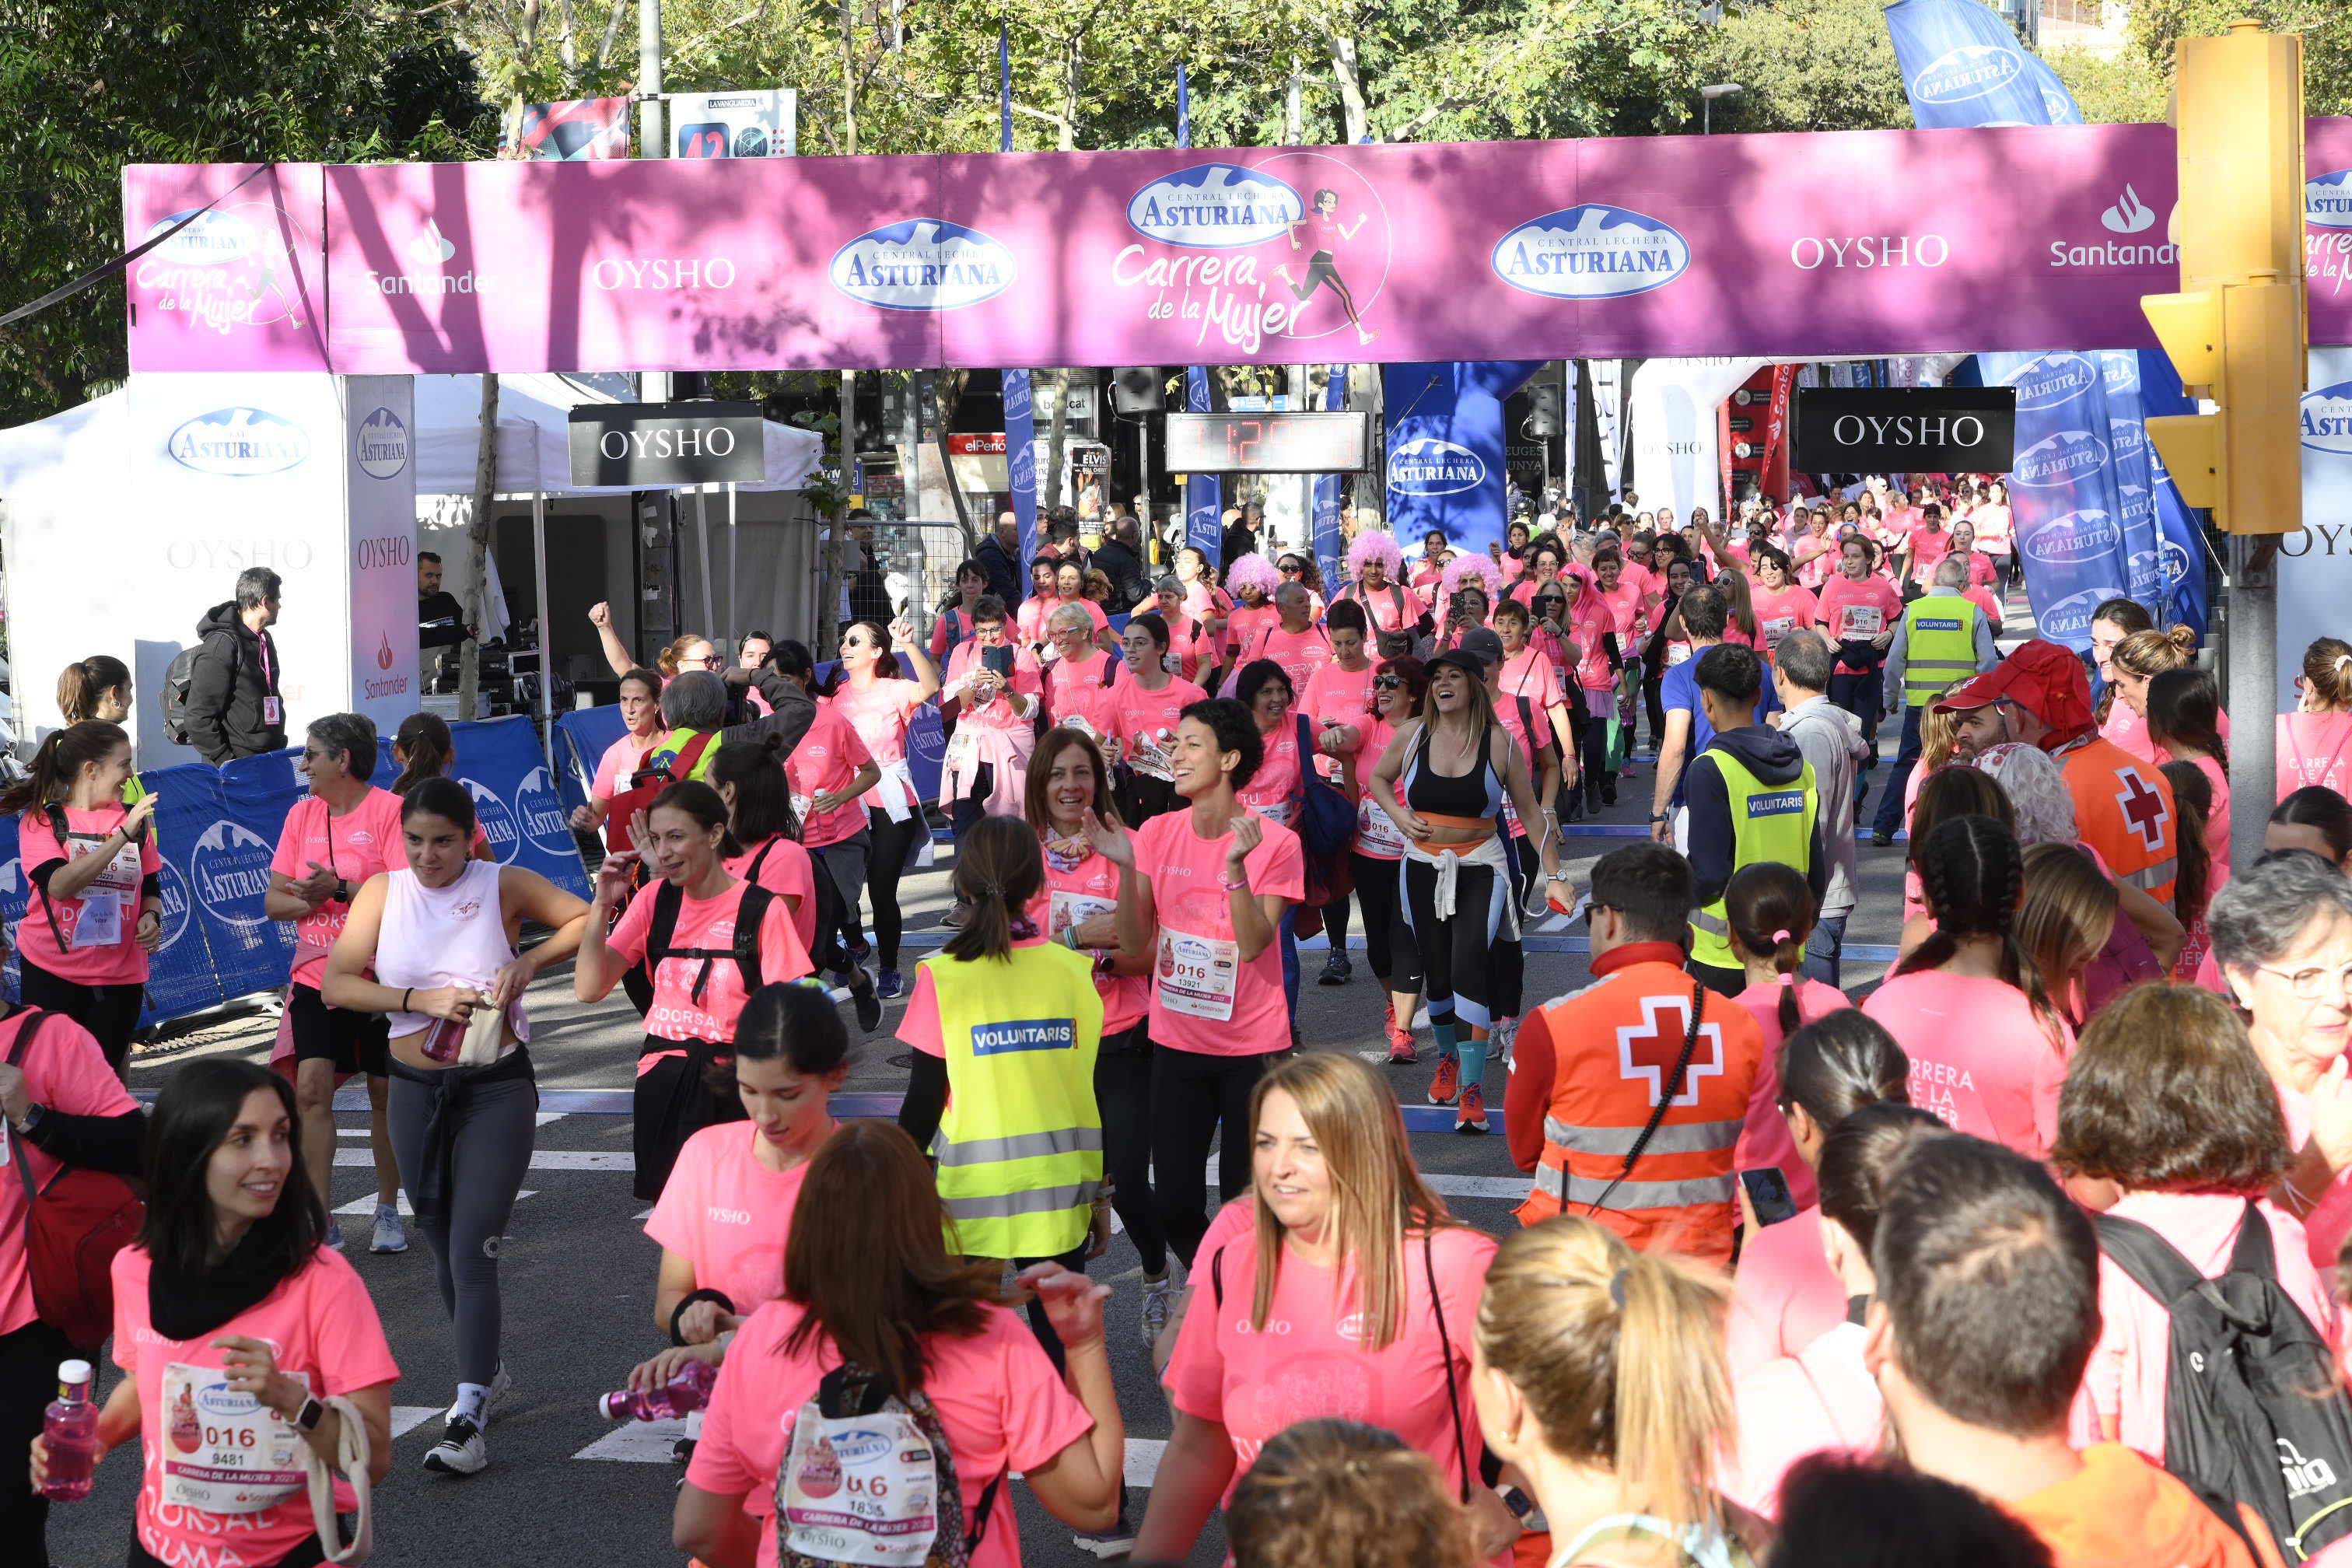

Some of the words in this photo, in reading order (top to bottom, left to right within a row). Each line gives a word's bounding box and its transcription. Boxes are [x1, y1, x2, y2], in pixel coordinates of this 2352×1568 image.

[1167, 192, 1224, 201] CENTRAL
[1229, 191, 1288, 201] LECHERA
[1141, 194, 1290, 228] ASTURIANA
[1537, 236, 1600, 247] CENTRAL
[1605, 236, 1668, 247] LECHERA
[1790, 234, 1949, 270] OYSHO
[873, 250, 933, 260] CENTRAL
[1112, 243, 1258, 287] Carrera
[1507, 240, 1675, 275] ASTURIANA
[2323, 254, 2337, 278] la
[137, 259, 227, 289] Carrera
[593, 258, 735, 290] OYSHO
[845, 253, 1002, 288] ASTURIANA
[364, 270, 500, 296] Santander
[159, 292, 176, 310] de
[190, 286, 261, 334] Mujer
[1148, 289, 1174, 320] de
[1181, 288, 1201, 320] la
[1195, 282, 1313, 355] Mujer
[1833, 415, 1984, 446] OYSHO
[360, 434, 405, 462] ASTURIANA
[600, 427, 737, 461] OYSHO
[1083, 454, 1107, 464] ELVIS
[1391, 460, 1479, 483] ASTURIANA
[358, 535, 411, 571] OYSHO
[365, 673, 409, 700] Santander
[530, 796, 556, 809] CENTRAL
[1748, 796, 1804, 813] VOLUNTARIS
[1372, 823, 1389, 833] 016
[208, 856, 240, 870] CENTRAL
[1159, 864, 1192, 877] OYSHO
[1177, 964, 1206, 978] 016
[1178, 978, 1200, 989] 13921
[660, 1007, 723, 1031] DORSAL
[974, 1026, 1071, 1048] VOLUNTARIS
[1930, 1083, 1955, 1108] LA
[206, 1426, 255, 1447] 016
[212, 1452, 244, 1466] 9481
[212, 1470, 224, 1479] DE
[226, 1472, 237, 1481] LA
[240, 1474, 271, 1482] MUJER
[802, 1512, 849, 1526] CARRERA
